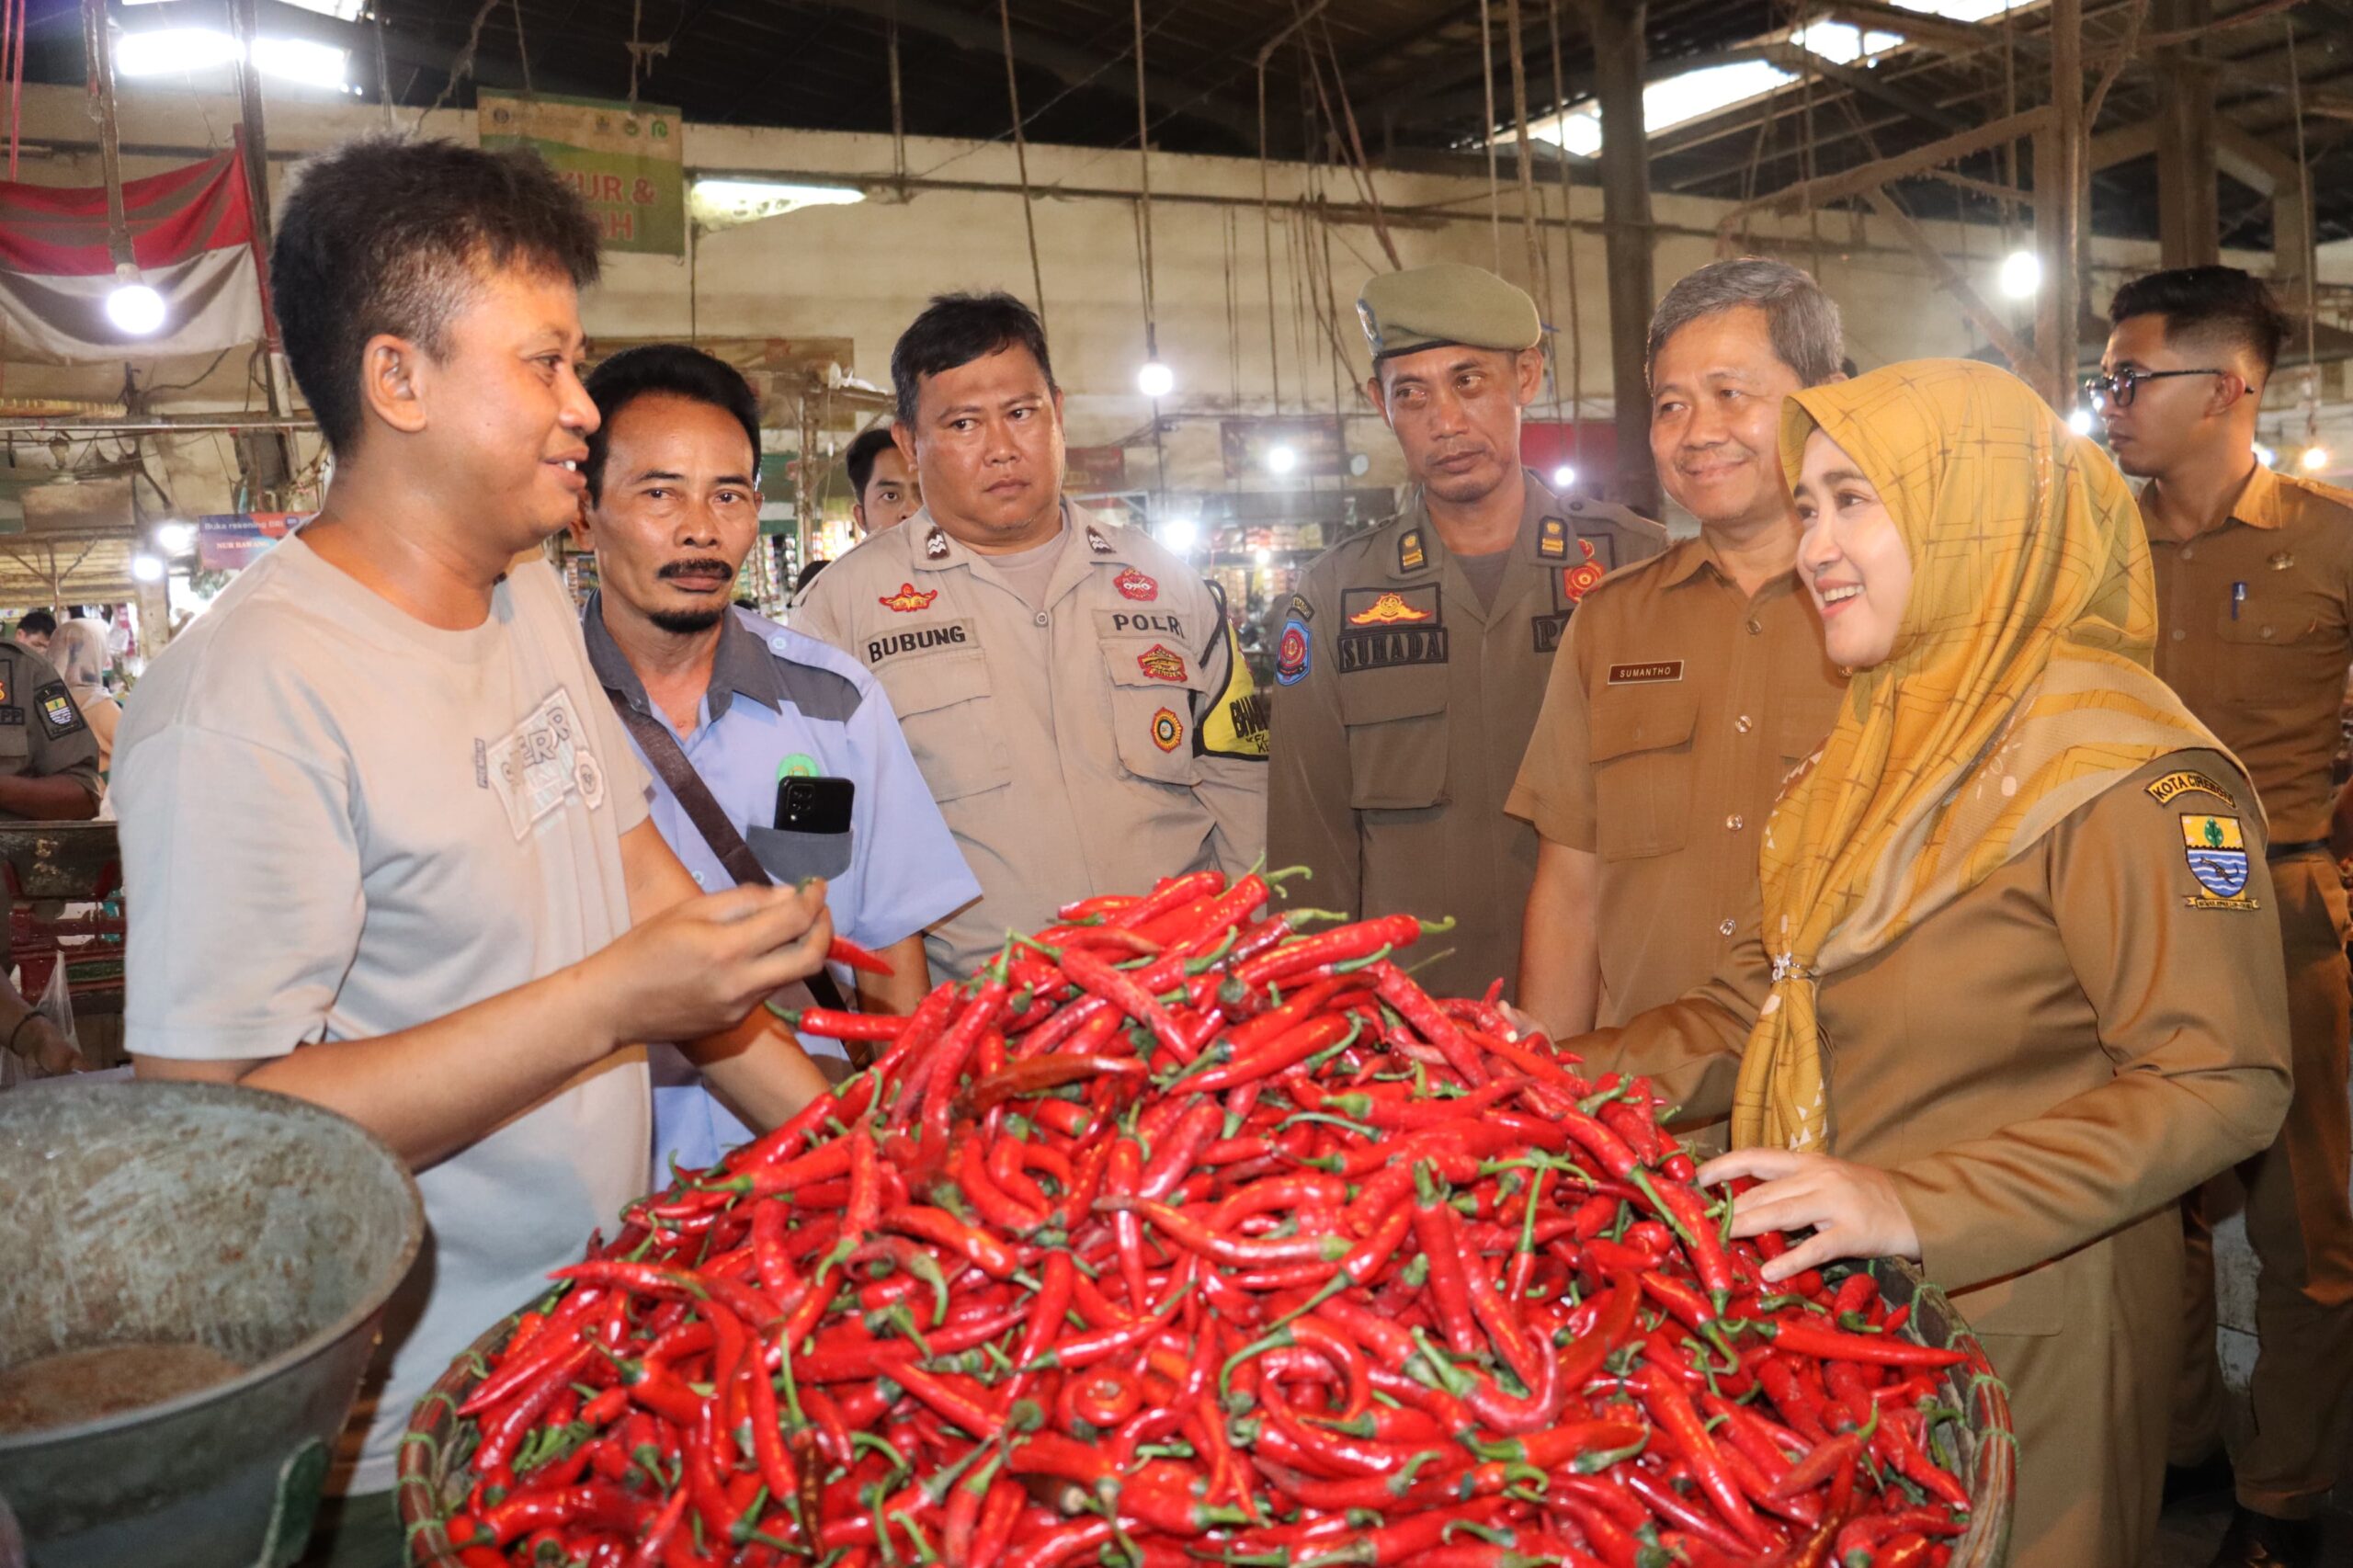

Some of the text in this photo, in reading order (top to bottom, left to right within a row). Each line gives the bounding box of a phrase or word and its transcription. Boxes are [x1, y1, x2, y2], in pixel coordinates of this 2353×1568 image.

[632, 178, 655, 204] &
[869, 626, 966, 663] BUBUNG
[1620, 666, 1671, 678] SUMANTHO
[2153, 775, 2187, 801] KOTA
